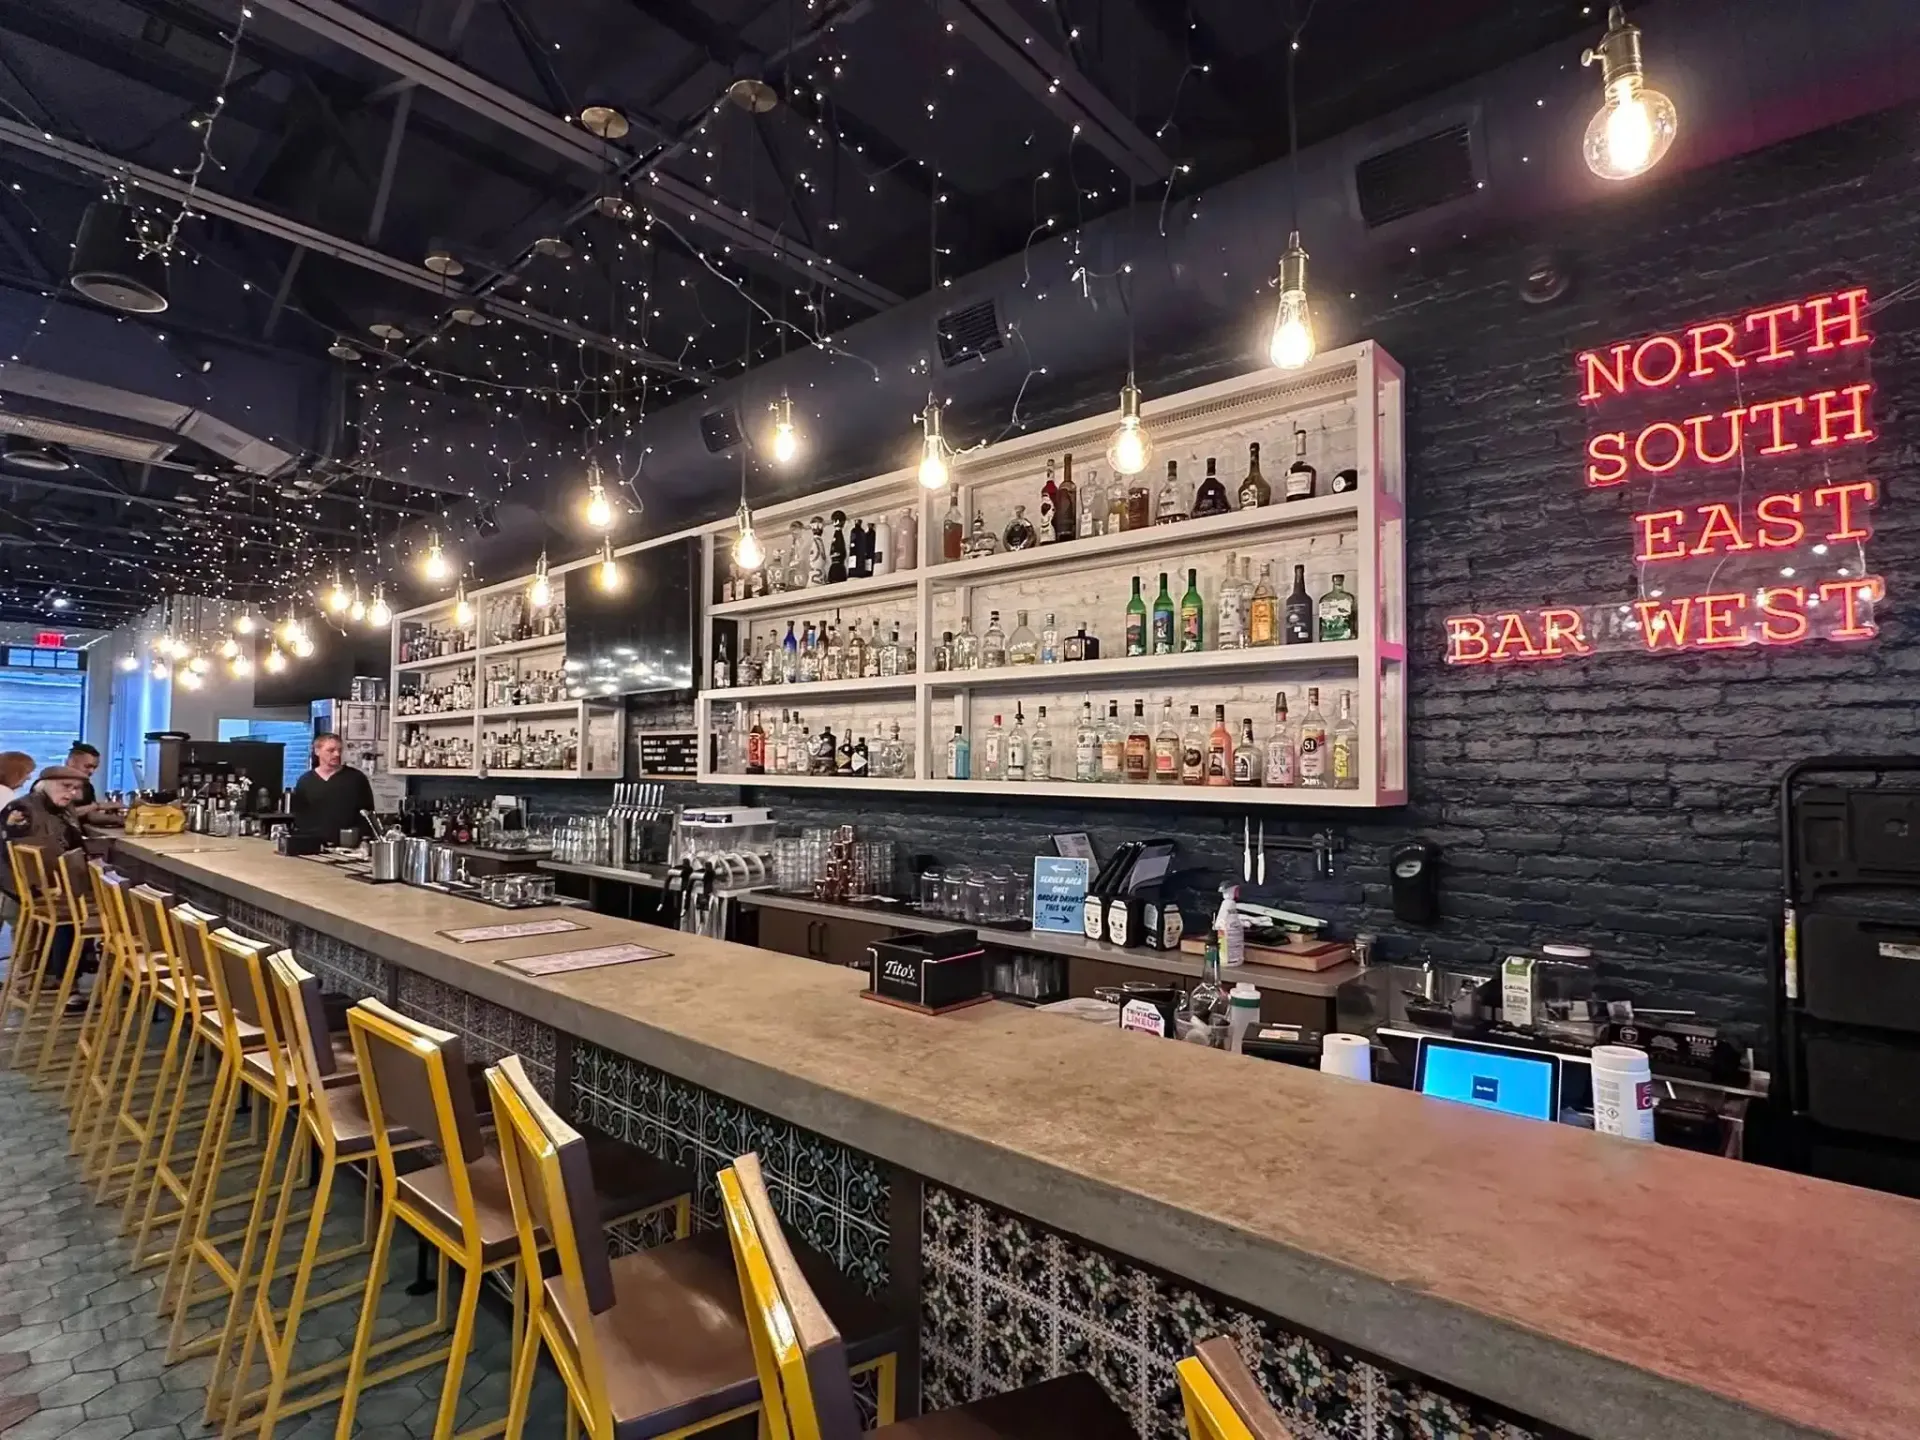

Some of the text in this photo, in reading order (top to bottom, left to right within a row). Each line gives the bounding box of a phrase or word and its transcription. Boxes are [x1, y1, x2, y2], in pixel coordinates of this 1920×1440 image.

[1578, 287, 1871, 405] NORTH
[1587, 385, 1875, 486] SOUTH
[1636, 482, 1876, 563] EAST
[1446, 578, 1879, 664] BAR WEST
[1304, 740, 1315, 749] 51
[1064, 877, 1082, 886] AREA
[1051, 885, 1070, 894] ONLY
[1037, 894, 1084, 904] ORDER DRINKS
[1045, 904, 1060, 912] THIS
[885, 960, 916, 979] Tito's
[1126, 1008, 1147, 1018] TRIVIA
[1126, 1015, 1161, 1028] LINEUP
